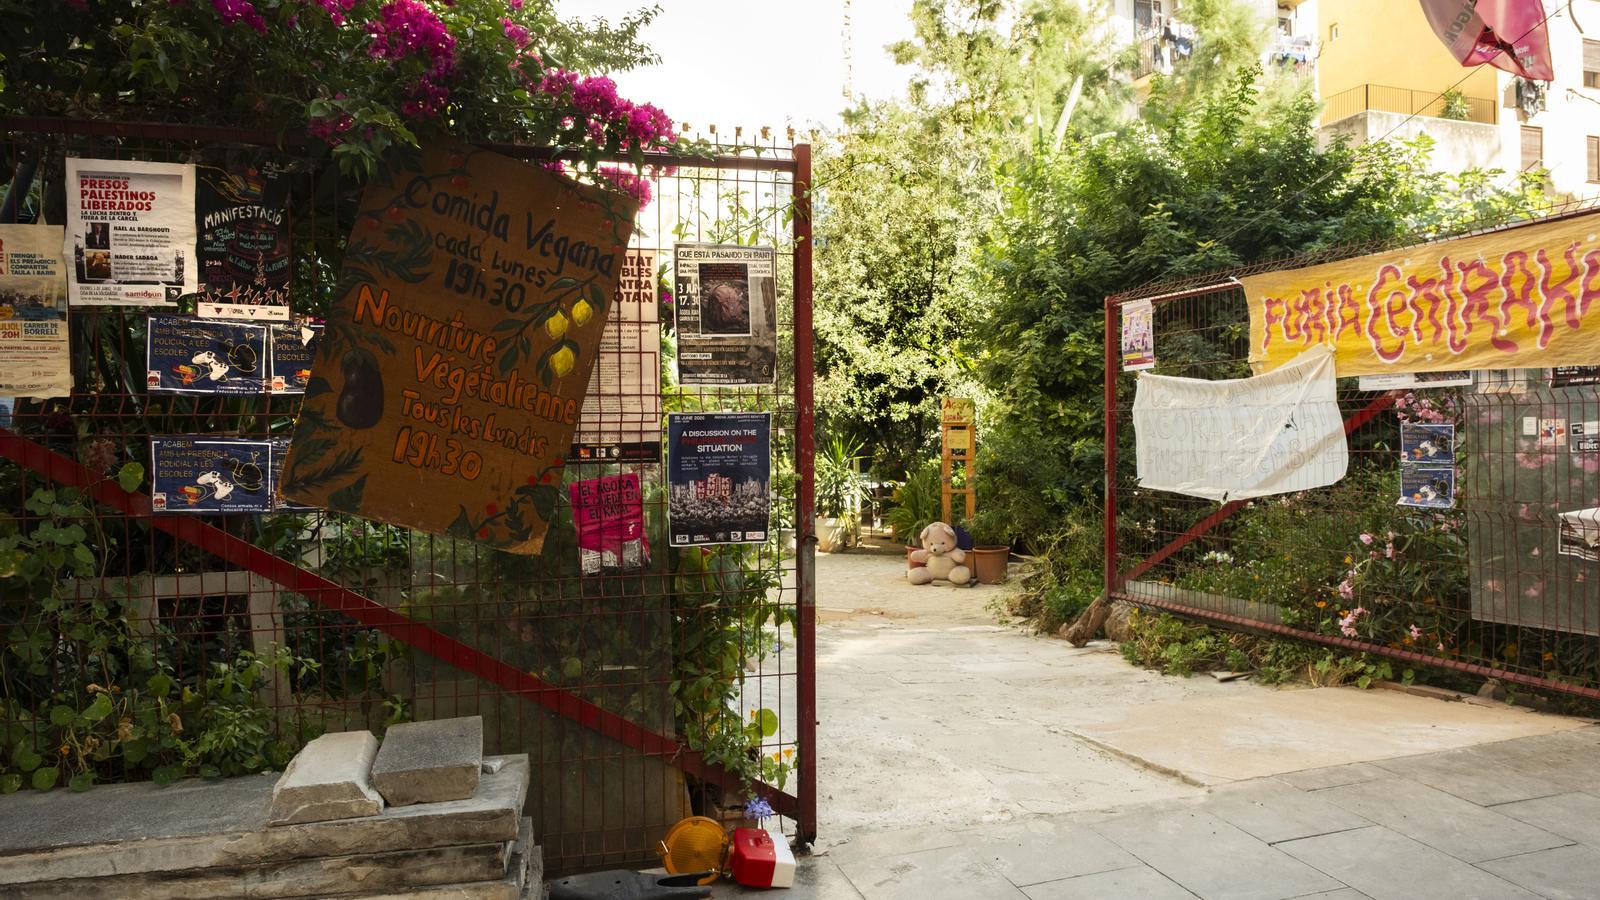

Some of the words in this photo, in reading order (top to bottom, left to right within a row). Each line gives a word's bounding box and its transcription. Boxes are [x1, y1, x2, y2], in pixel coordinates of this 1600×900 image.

[80, 179, 129, 190] PRESOS
[80, 189, 156, 201] PALESTINOS
[80, 200, 152, 211] LIBERADOS
[204, 206, 286, 230] MANIFESTACIÓ
[403, 175, 510, 242] Comida
[526, 212, 615, 279] Vegana
[435, 231, 482, 263] cada
[491, 251, 549, 289] Lunes
[712, 251, 742, 259] PASANDO
[124, 290, 162, 298] samidoun
[678, 284, 684, 294] 3
[352, 283, 498, 366] Nourriture
[154, 338, 186, 346] POLICIAL
[154, 348, 188, 356] ESCOLES
[415, 345, 580, 426] Végétalienne
[402, 387, 450, 429] Tous
[450, 405, 483, 440] les
[482, 413, 549, 460] Lundis
[162, 440, 193, 448] ACABEM
[697, 444, 743, 452] SITUATION
[392, 425, 484, 482] 19h30
[160, 460, 192, 468] POLICIAL
[160, 470, 193, 478] ESCOLES
